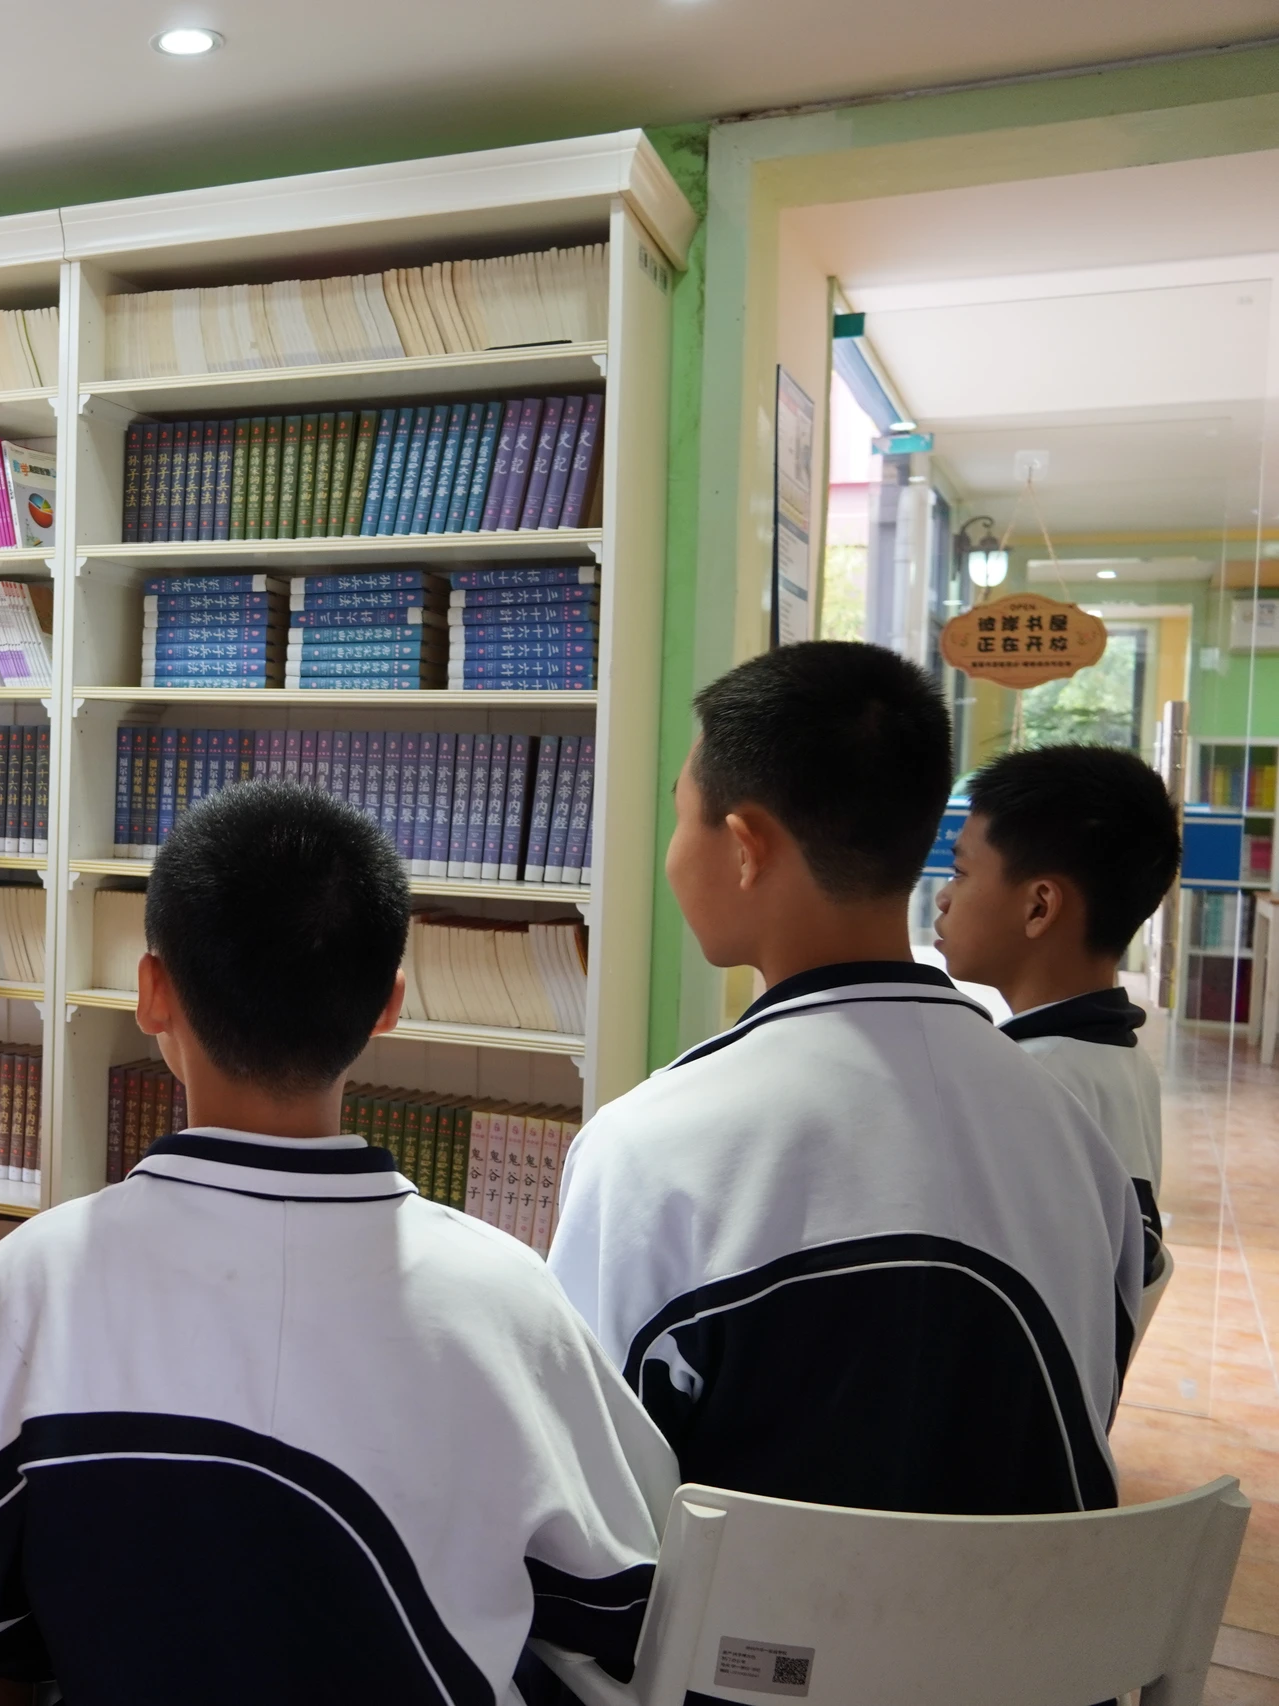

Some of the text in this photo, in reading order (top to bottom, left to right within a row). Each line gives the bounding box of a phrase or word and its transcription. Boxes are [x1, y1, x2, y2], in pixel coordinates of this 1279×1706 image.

[468, 1148, 484, 1199] 鬼谷子
[486, 1150, 502, 1202] 鬼谷子
[504, 1152, 520, 1204] 鬼谷子
[521, 1154, 538, 1206] 鬼谷子
[538, 1156, 556, 1208] 鬼谷子
